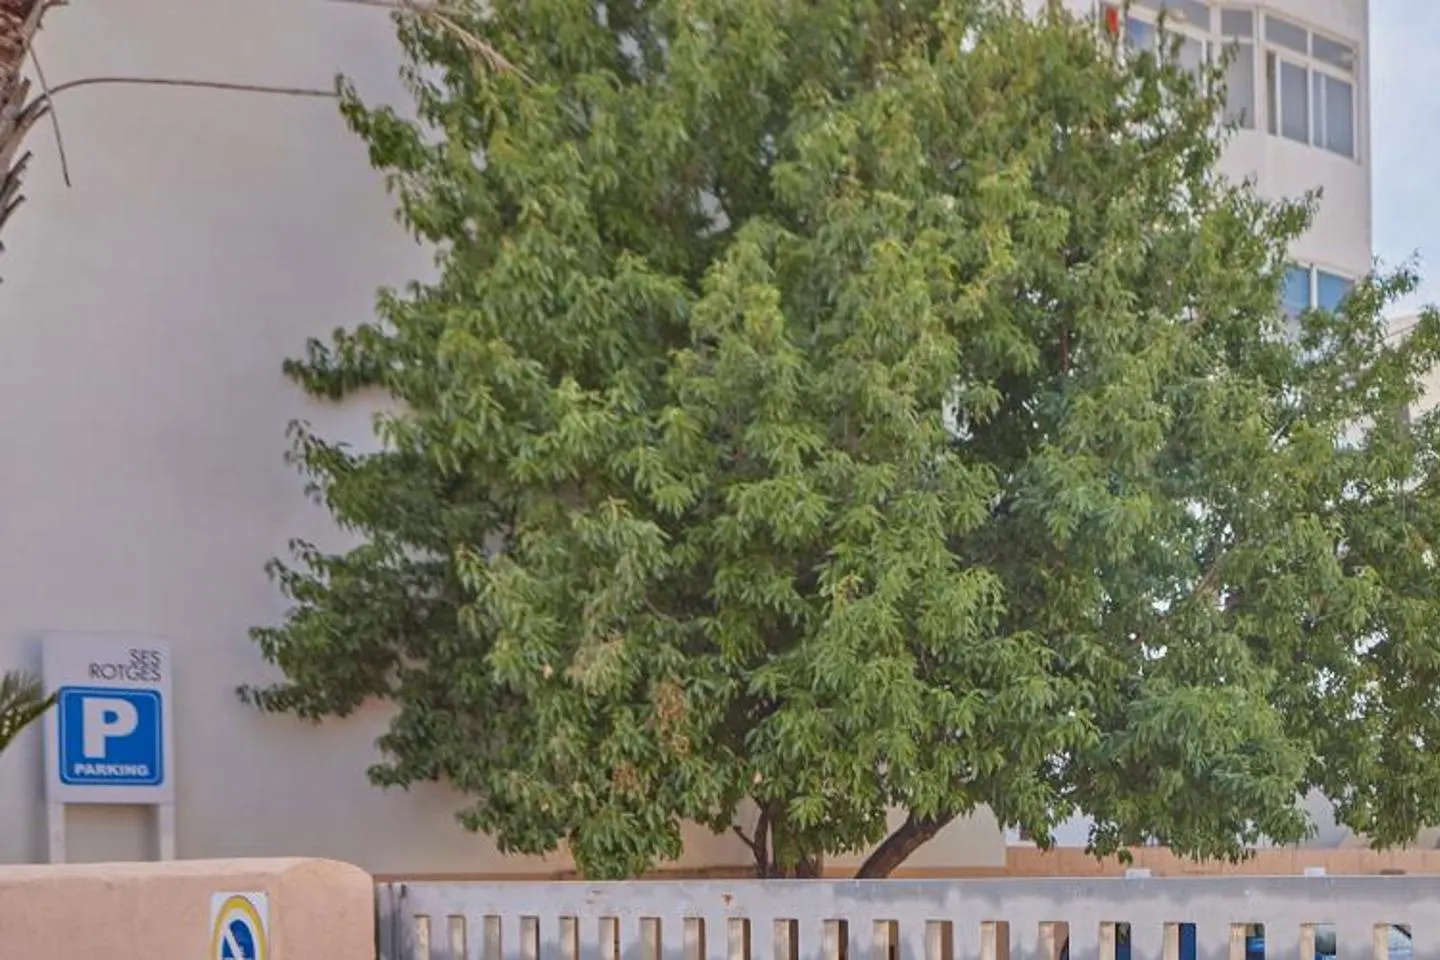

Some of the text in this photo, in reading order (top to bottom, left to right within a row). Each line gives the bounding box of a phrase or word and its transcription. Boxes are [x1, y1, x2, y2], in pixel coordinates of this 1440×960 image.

[129, 648, 161, 665] SES
[89, 663, 162, 682] ROTGES
[82, 696, 139, 759] P
[73, 762, 150, 777] PARKING
